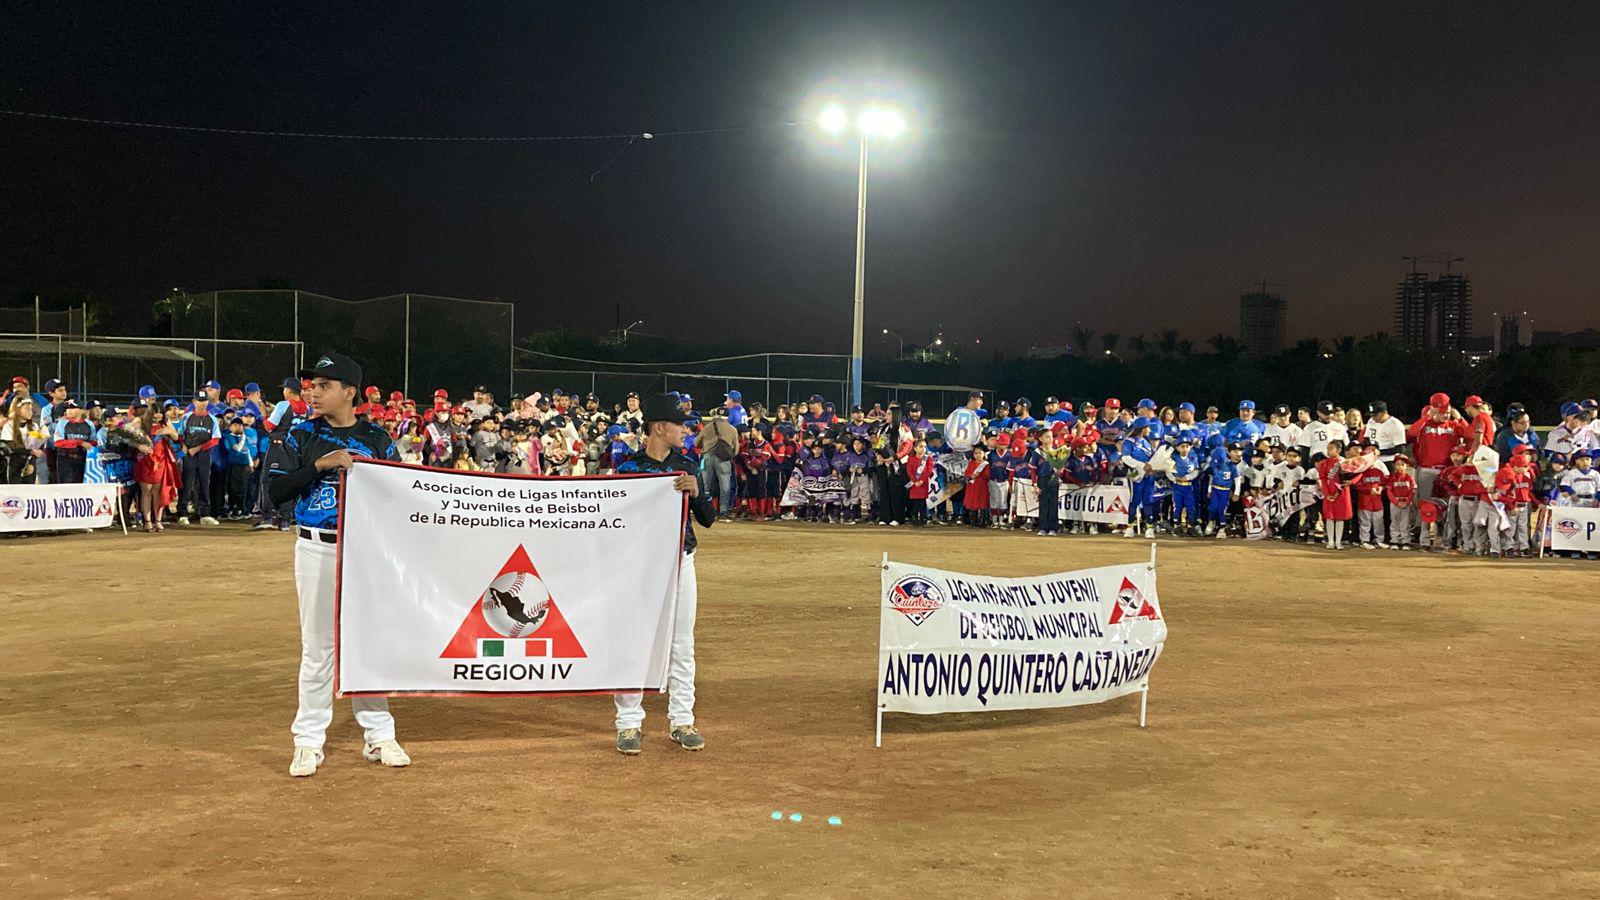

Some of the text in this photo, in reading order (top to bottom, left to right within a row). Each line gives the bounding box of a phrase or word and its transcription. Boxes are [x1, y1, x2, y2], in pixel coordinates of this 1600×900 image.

[309, 486, 336, 510] 23
[412, 479, 627, 501] Asociacion de Ligas Infantiles
[25, 498, 94, 519] JUV. MENOR
[441, 499, 601, 514] y Juveniles de Beisbol
[410, 512, 626, 530] de la Republica Mexicana A.C.
[1586, 522, 1596, 541] P
[945, 578, 980, 601] LIGA
[979, 580, 1035, 608] INFANTIL
[1034, 584, 1046, 604] Y
[1050, 577, 1100, 603] JUVENIL
[960, 612, 1103, 641] DE BEISBOL MUNICIPAL
[453, 664, 573, 681] REGION IV
[883, 652, 972, 698] ANTONIO
[977, 652, 1069, 706] QUINTERO
